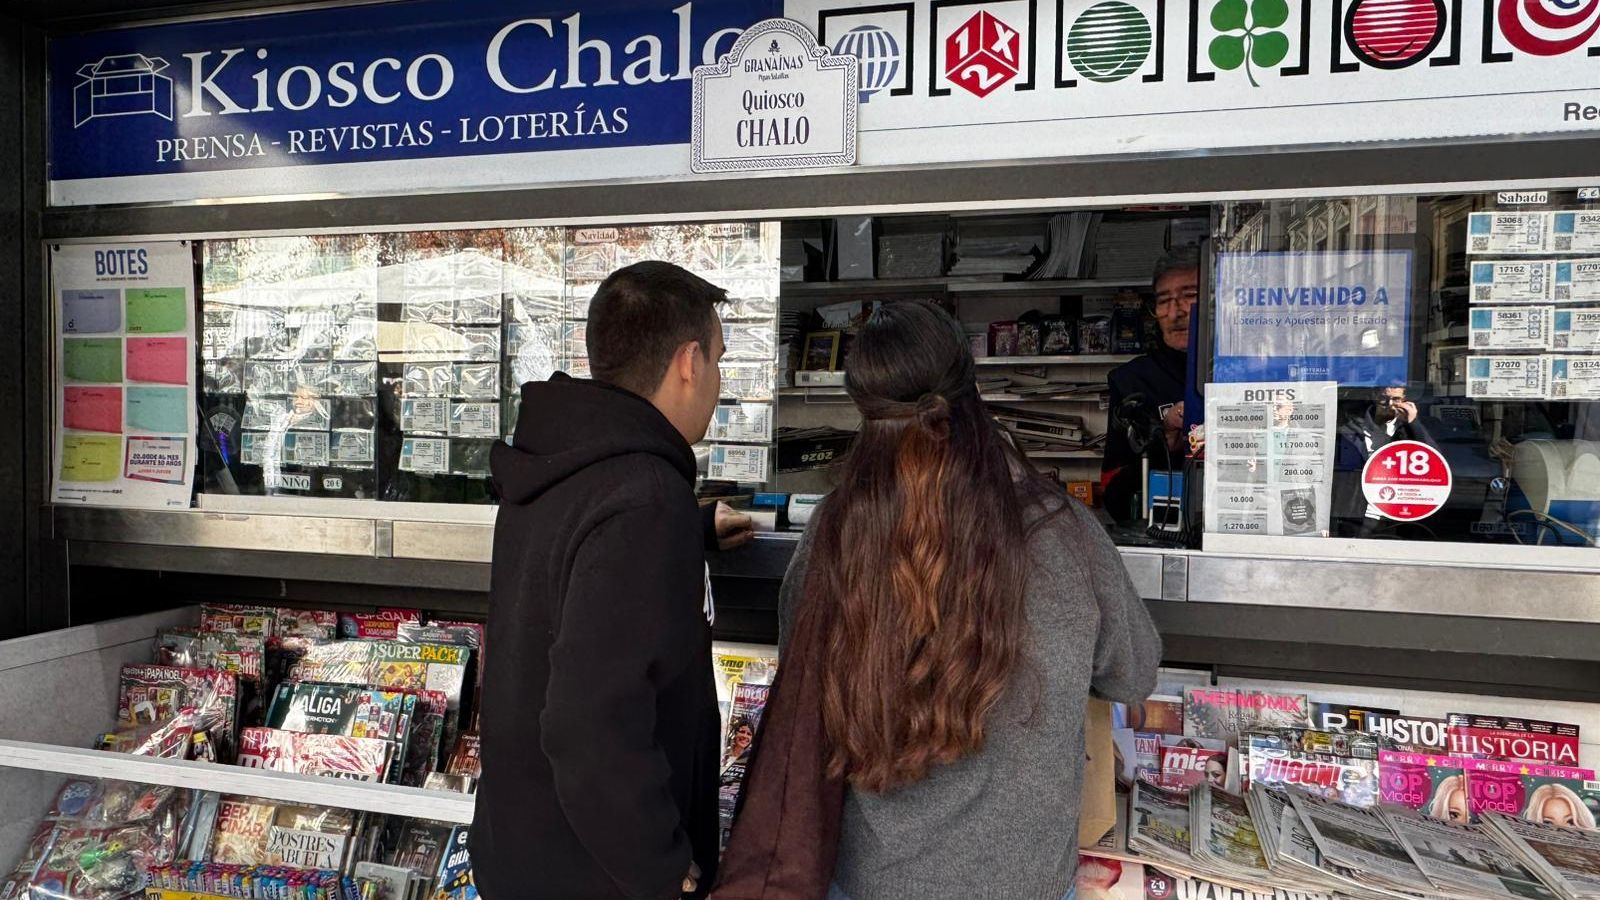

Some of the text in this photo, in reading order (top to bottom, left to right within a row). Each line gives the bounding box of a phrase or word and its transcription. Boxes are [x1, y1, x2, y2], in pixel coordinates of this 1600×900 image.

[744, 54, 804, 73] GRANAÍNAS
[955, 21, 1014, 90] 1 X 2
[181, 48, 455, 119] Kiosco
[742, 90, 805, 115] Quiosco
[156, 135, 266, 164] PRENSA
[287, 120, 433, 153] REVISTAS
[460, 105, 628, 144] LOTERÍAS
[736, 116, 810, 148] CHALO
[1498, 192, 1547, 203] Sabado
[581, 231, 615, 240] Navidad
[95, 248, 148, 275] BOTES
[1235, 286, 1389, 307] BIENVENIDO A
[1352, 314, 1388, 325] Estado
[1244, 389, 1296, 402] BOTES
[801, 451, 833, 462] 2026
[1381, 450, 1430, 475] +18
[283, 475, 310, 488] NIÑO
[1191, 688, 1301, 713] THERMOMIX
[1450, 733, 1577, 762] HISTORIA
[1382, 772, 1424, 791] TOP
[1471, 781, 1517, 800] TOP
[1381, 789, 1424, 804] Model
[1472, 798, 1518, 813] Model
[274, 831, 336, 853] POSTRES
[280, 847, 333, 869] ABUELA
